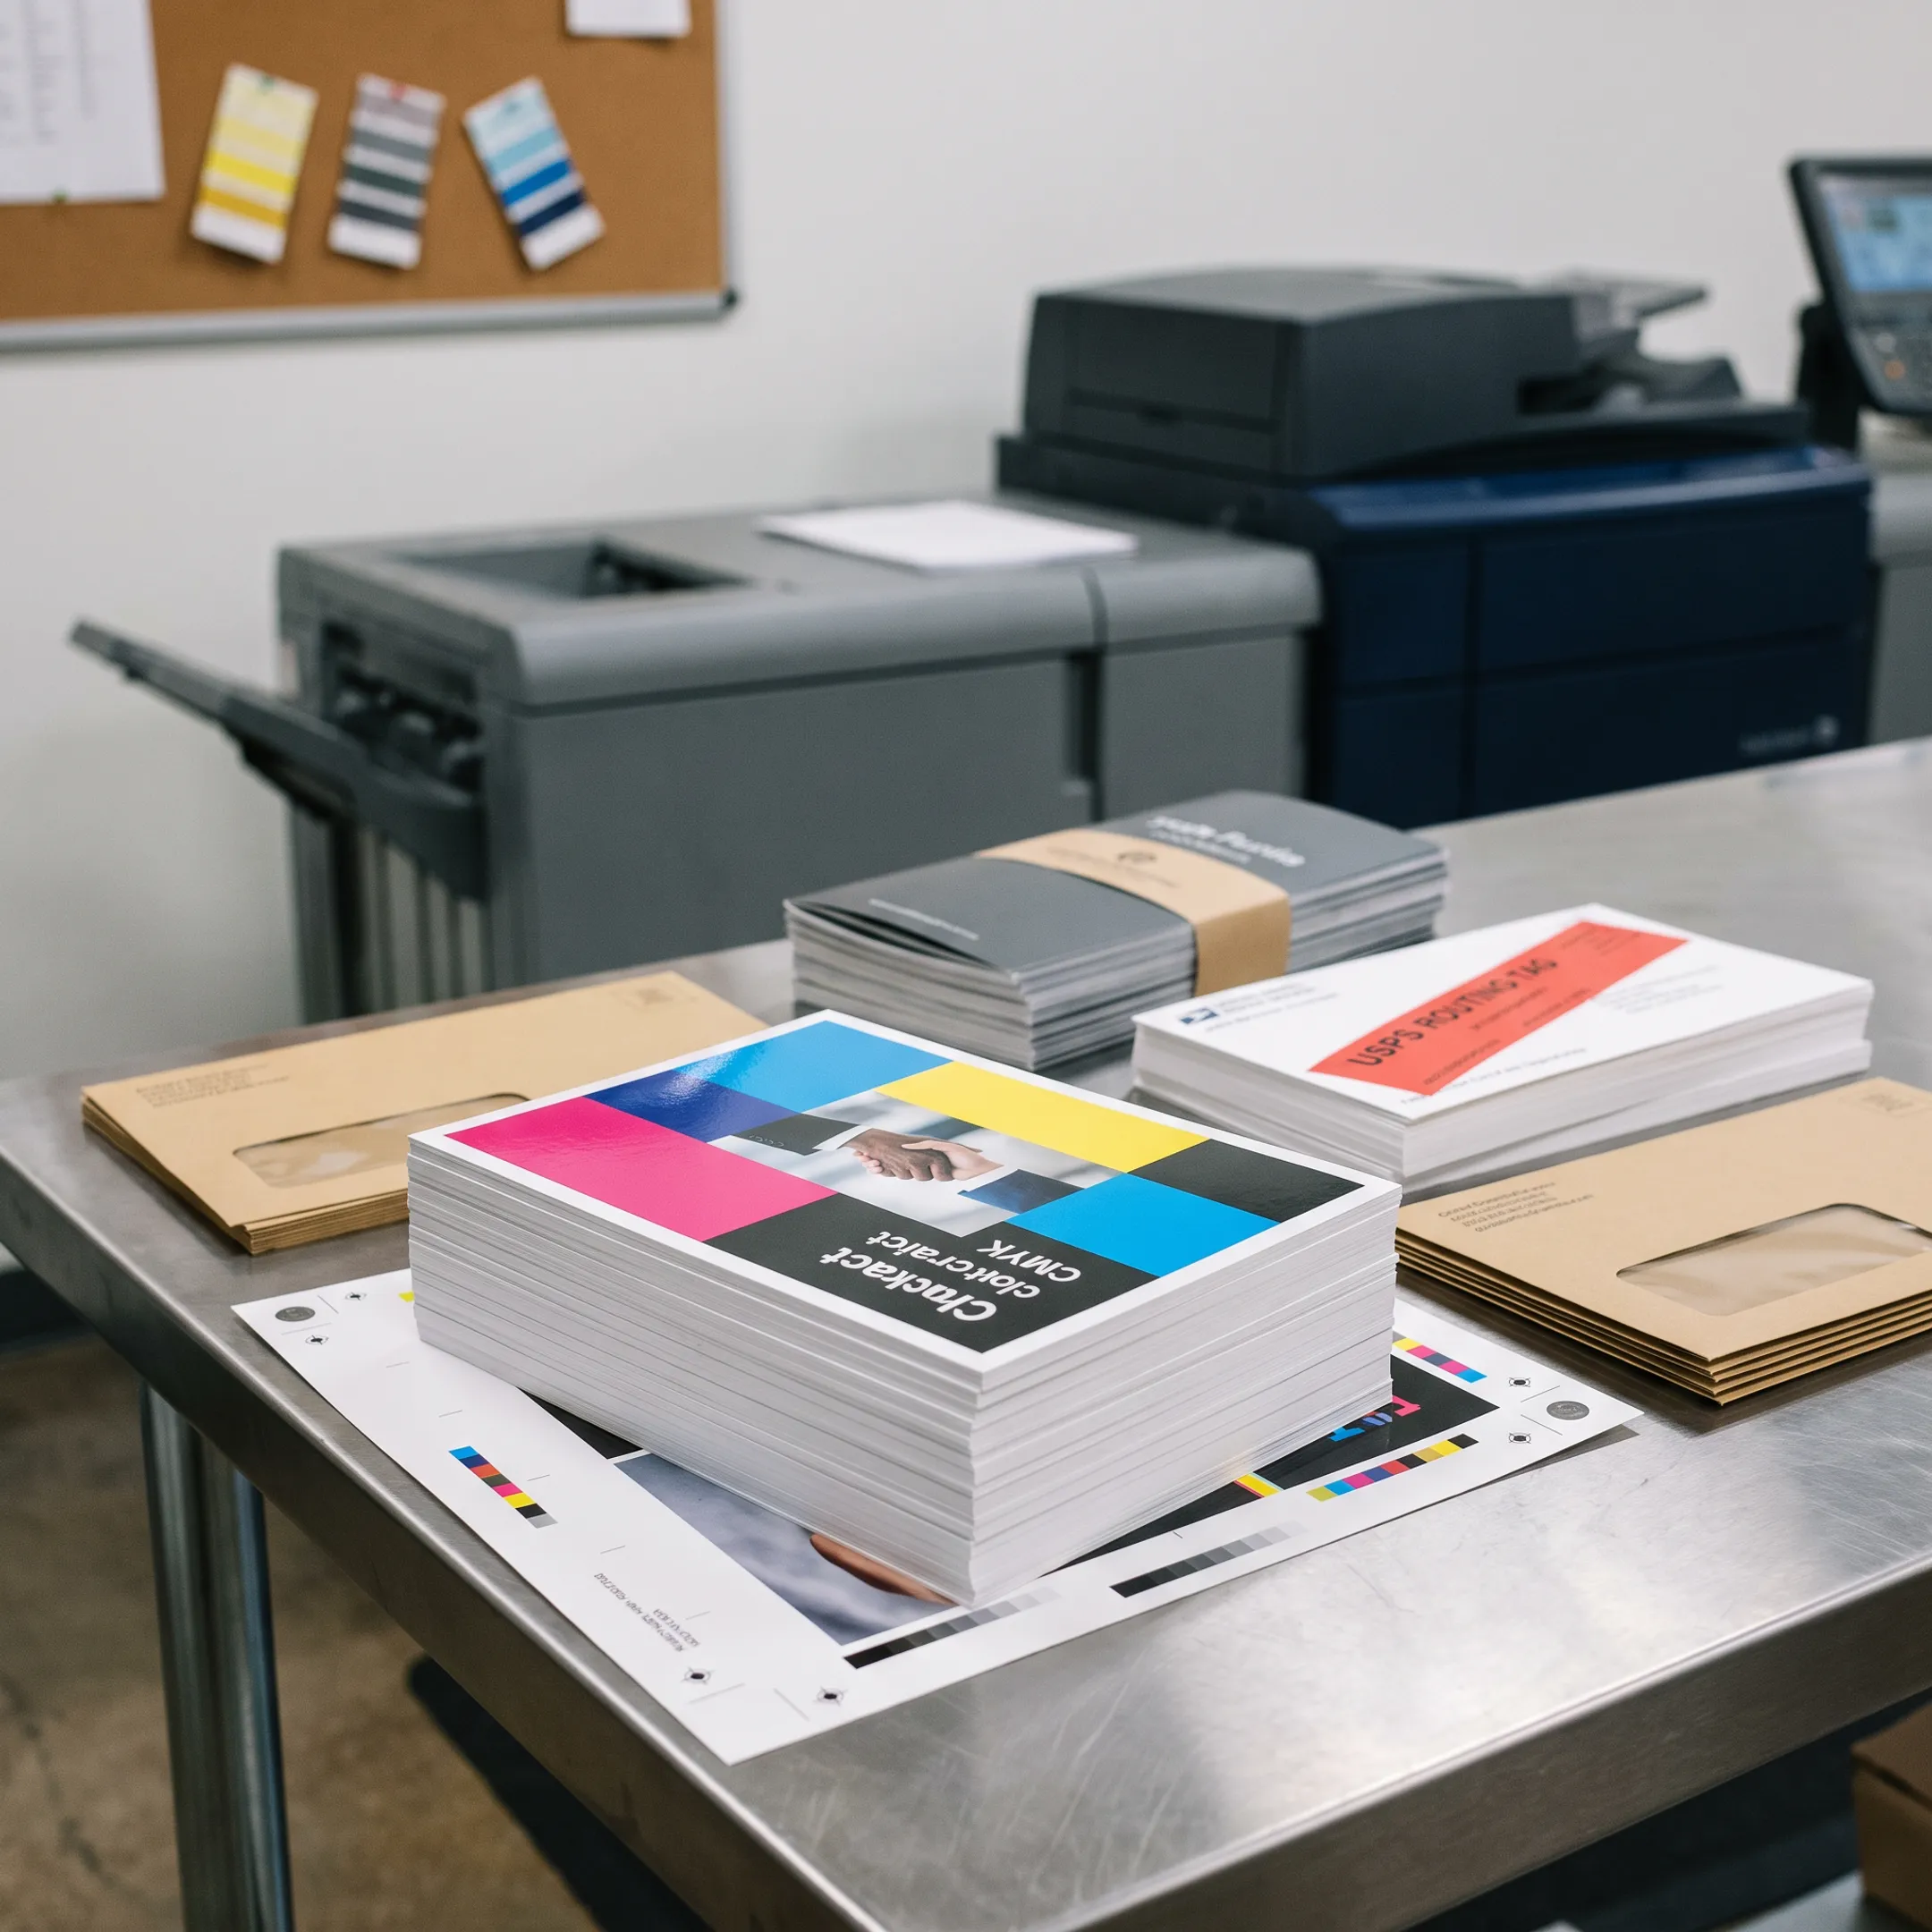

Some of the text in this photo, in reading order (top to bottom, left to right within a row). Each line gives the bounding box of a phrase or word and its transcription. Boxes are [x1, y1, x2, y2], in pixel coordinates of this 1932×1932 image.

[1346, 1029, 1425, 1067] USPS
[1412, 978, 1519, 1030] ROUTING
[976, 1239, 1081, 1283] CMYK
